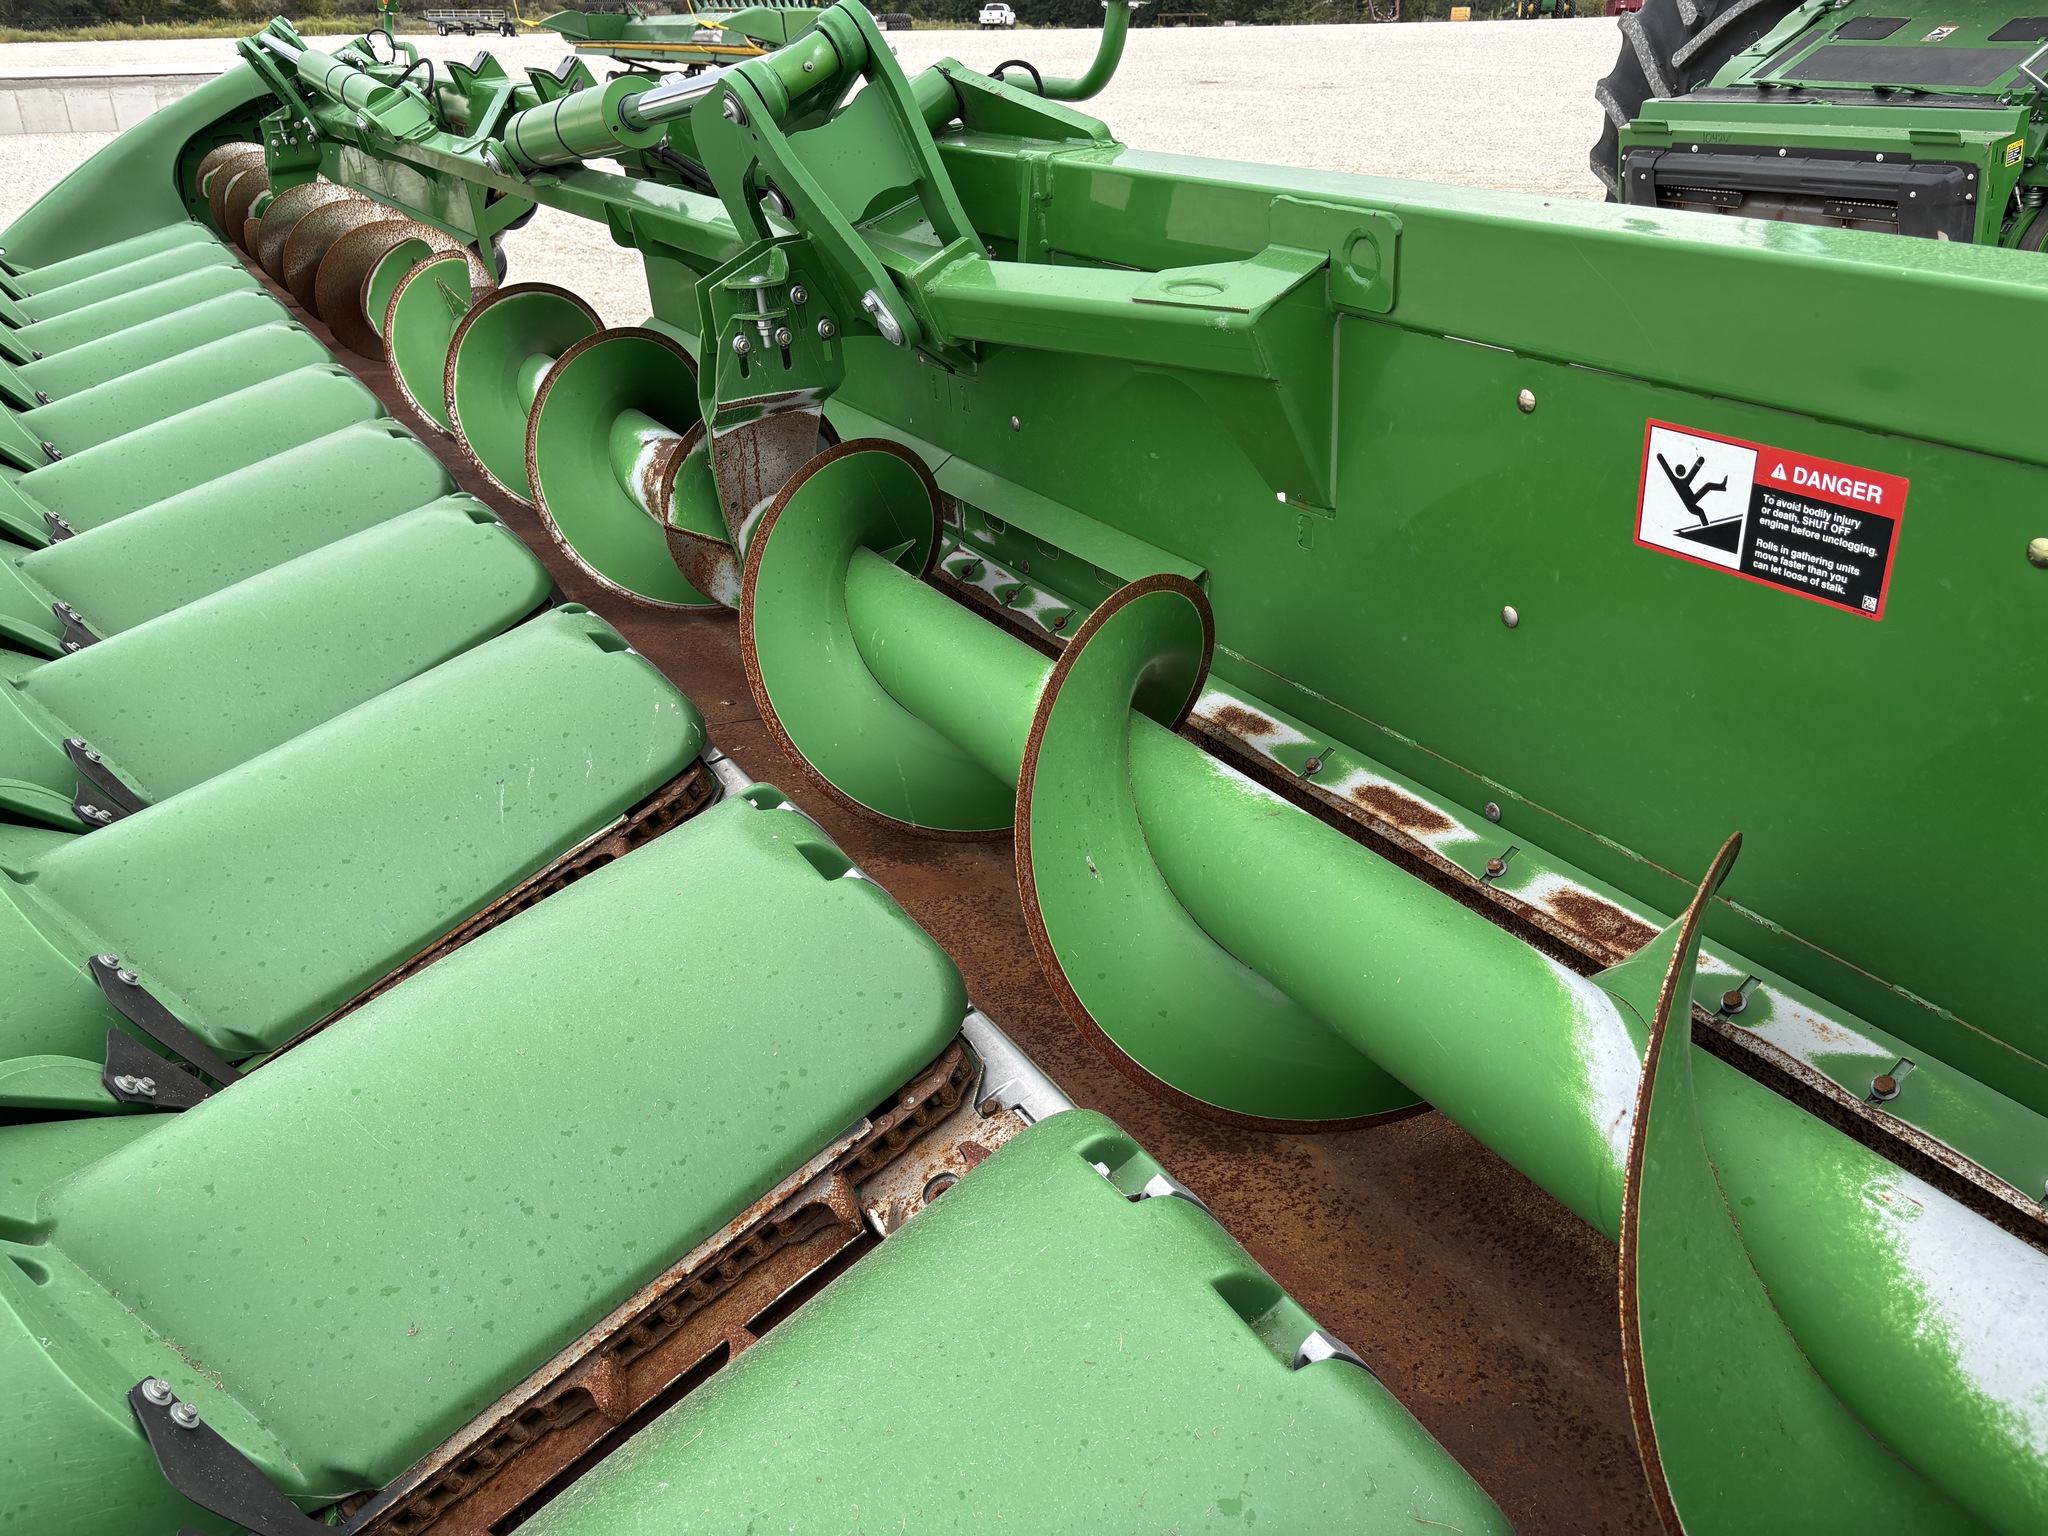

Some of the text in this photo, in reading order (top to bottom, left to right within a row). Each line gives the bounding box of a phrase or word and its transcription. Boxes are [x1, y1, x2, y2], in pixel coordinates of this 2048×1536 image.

[1793, 466, 1883, 504] DANGER
[1761, 507, 1852, 536] or death, SHUT OFF
[1763, 494, 1861, 530] To avoid bodily injury
[1759, 517, 1878, 558] engine before unclogging.
[1754, 550, 1848, 584] move faster than you
[1756, 538, 1860, 576] Rolls in gathering units
[1752, 560, 1846, 595] can let loose of stalk.
